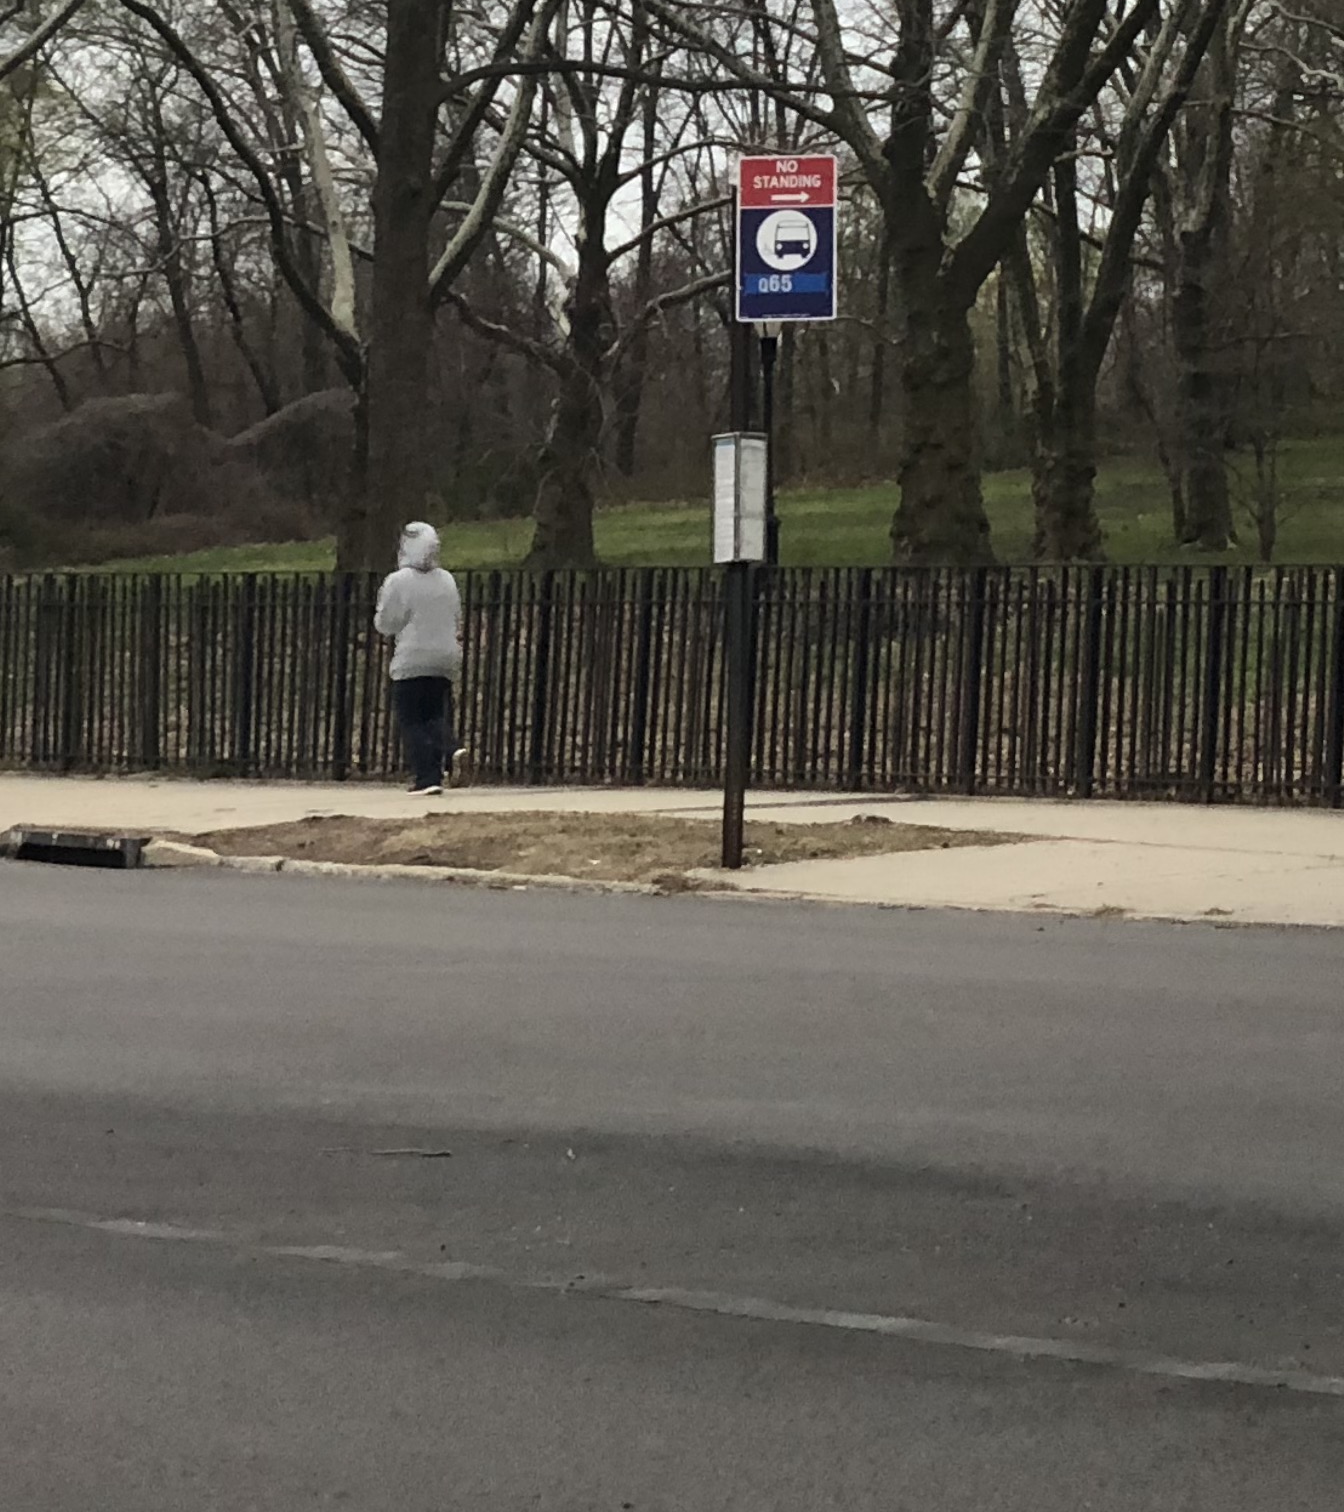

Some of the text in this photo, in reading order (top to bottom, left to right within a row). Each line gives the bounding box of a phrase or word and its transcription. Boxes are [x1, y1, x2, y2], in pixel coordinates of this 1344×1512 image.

[776, 161, 798, 173] NO
[753, 175, 821, 188] STANDING
[758, 274, 793, 293] Q65
